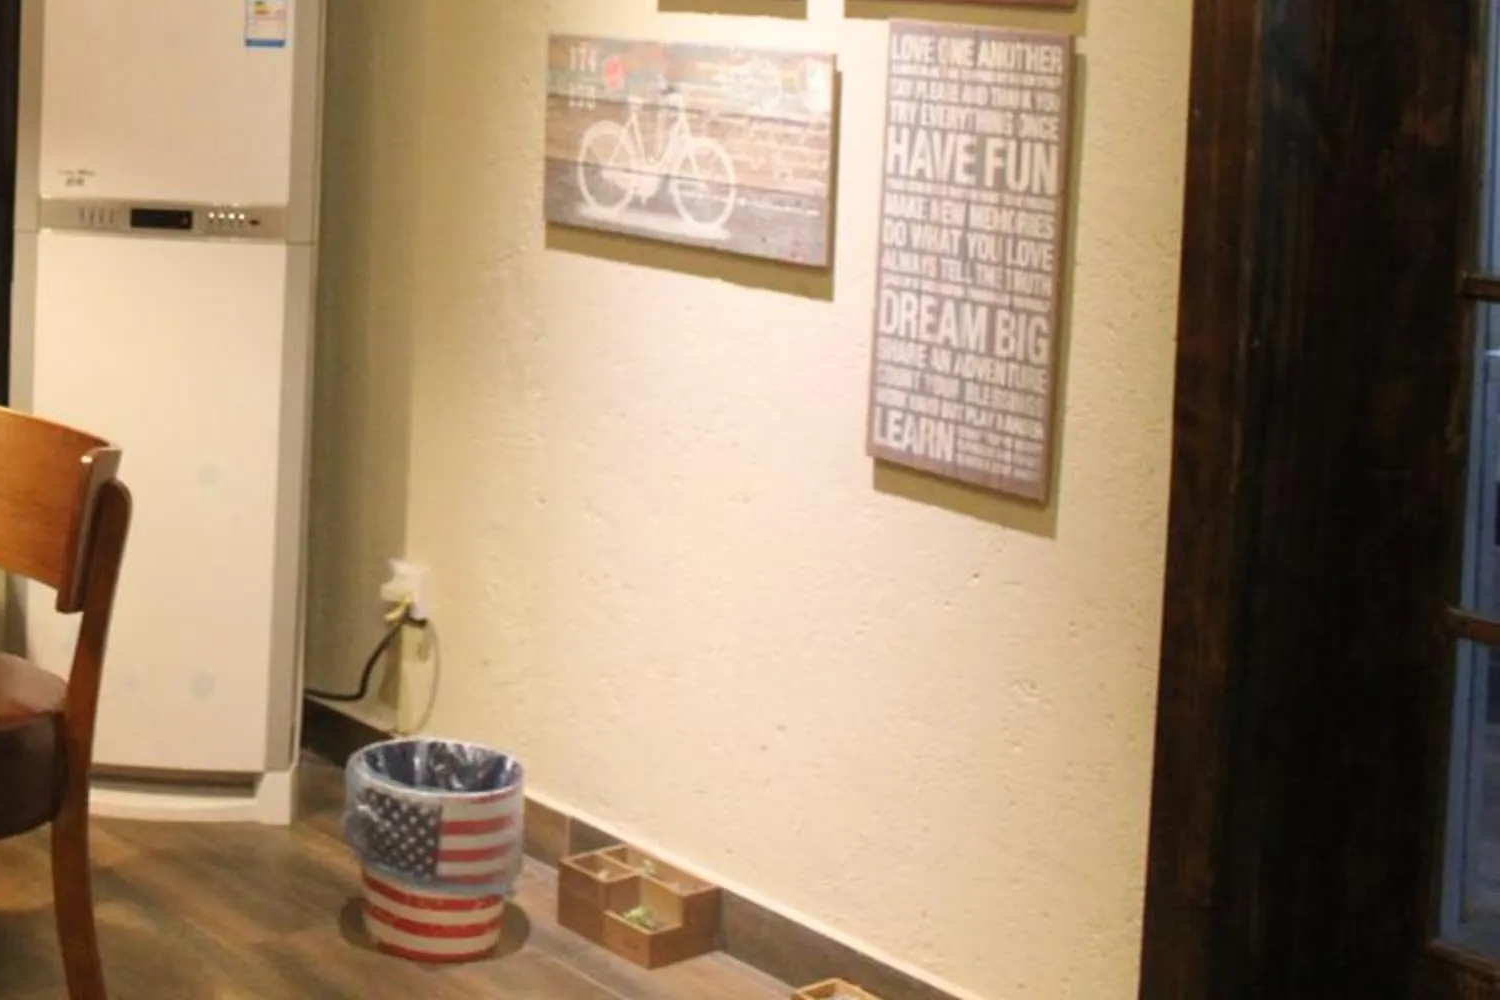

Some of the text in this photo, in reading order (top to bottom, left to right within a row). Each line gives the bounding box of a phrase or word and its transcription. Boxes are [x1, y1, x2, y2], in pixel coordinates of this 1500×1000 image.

[891, 32, 1062, 73] LOVE ONE ANOTHER
[886, 125, 976, 185] HAVE
[984, 137, 1059, 195] FUN
[910, 223, 962, 256] WHAT
[966, 231, 1003, 261] YOU
[1006, 238, 1055, 271] LOVE
[879, 289, 988, 353] DREAM
[995, 309, 1050, 364] BIG
[873, 406, 955, 462] LEARN
